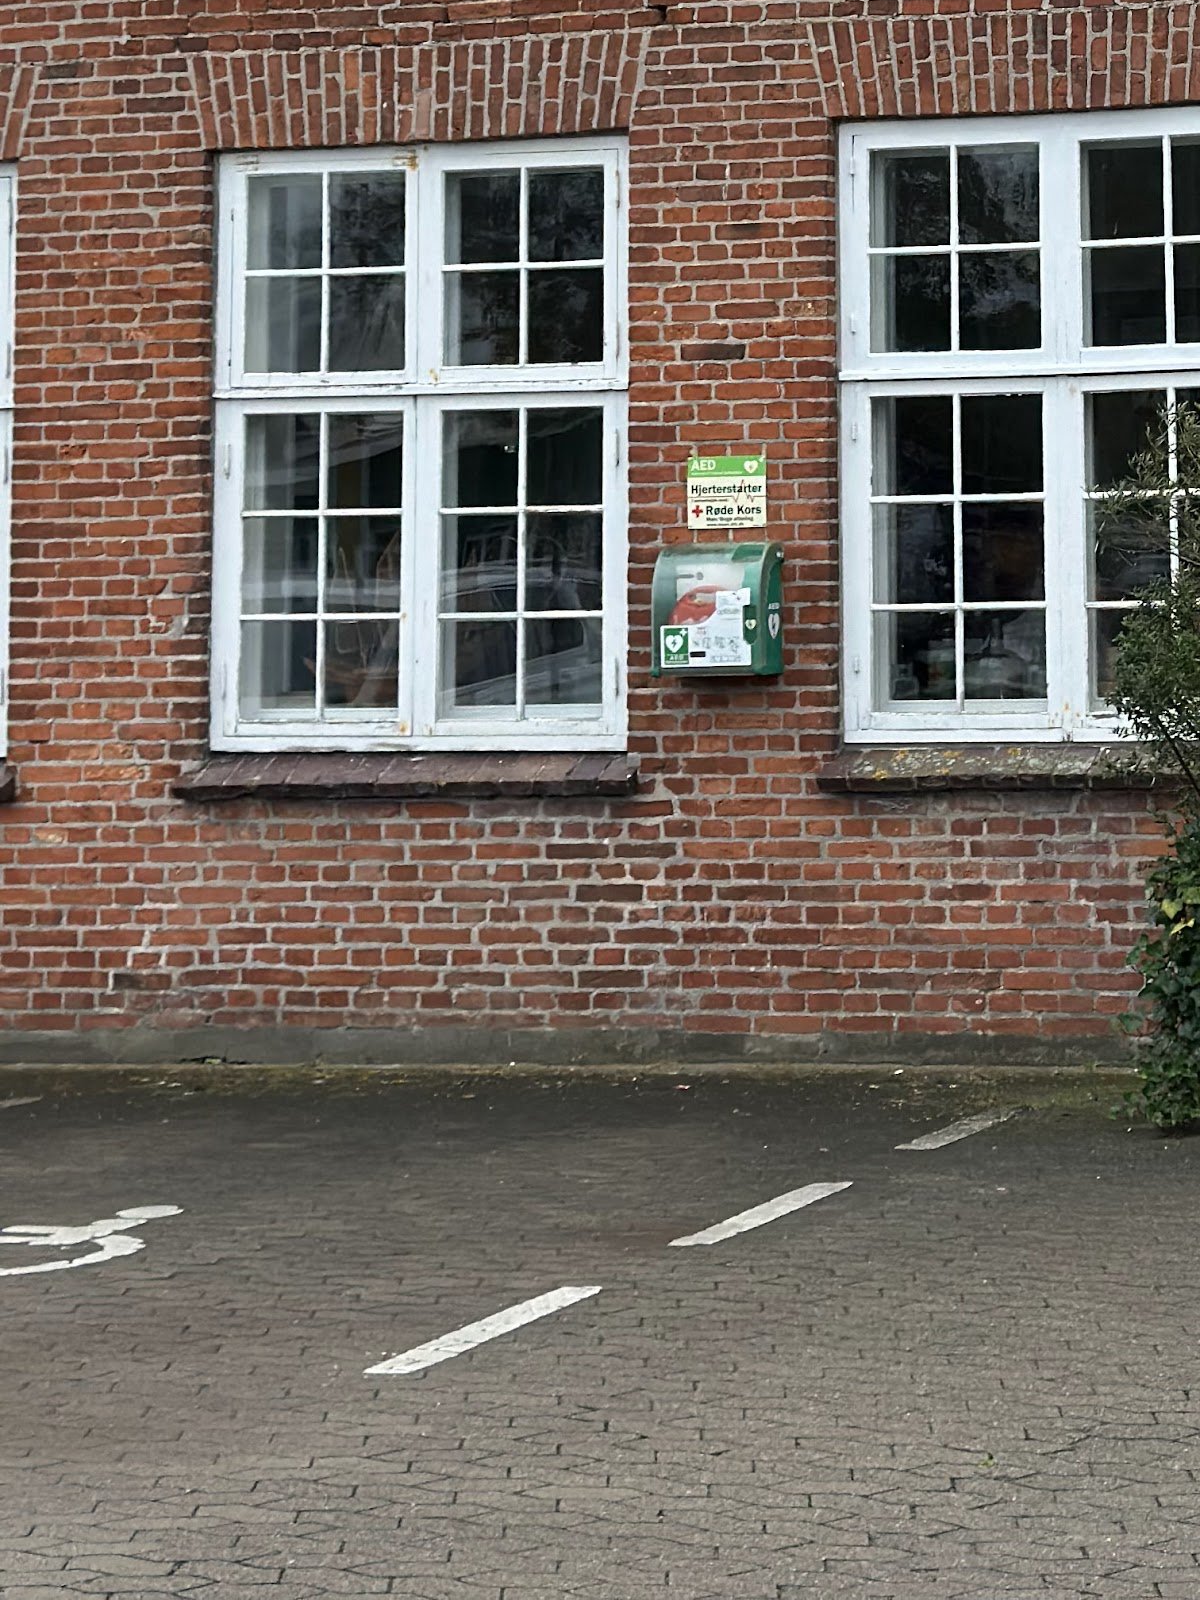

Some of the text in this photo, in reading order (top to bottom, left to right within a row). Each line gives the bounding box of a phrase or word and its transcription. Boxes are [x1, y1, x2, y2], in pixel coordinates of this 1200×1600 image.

[691, 460, 716, 471] AED
[691, 484, 762, 496] Hjerterstarter
[706, 505, 762, 515] Røde Kors
